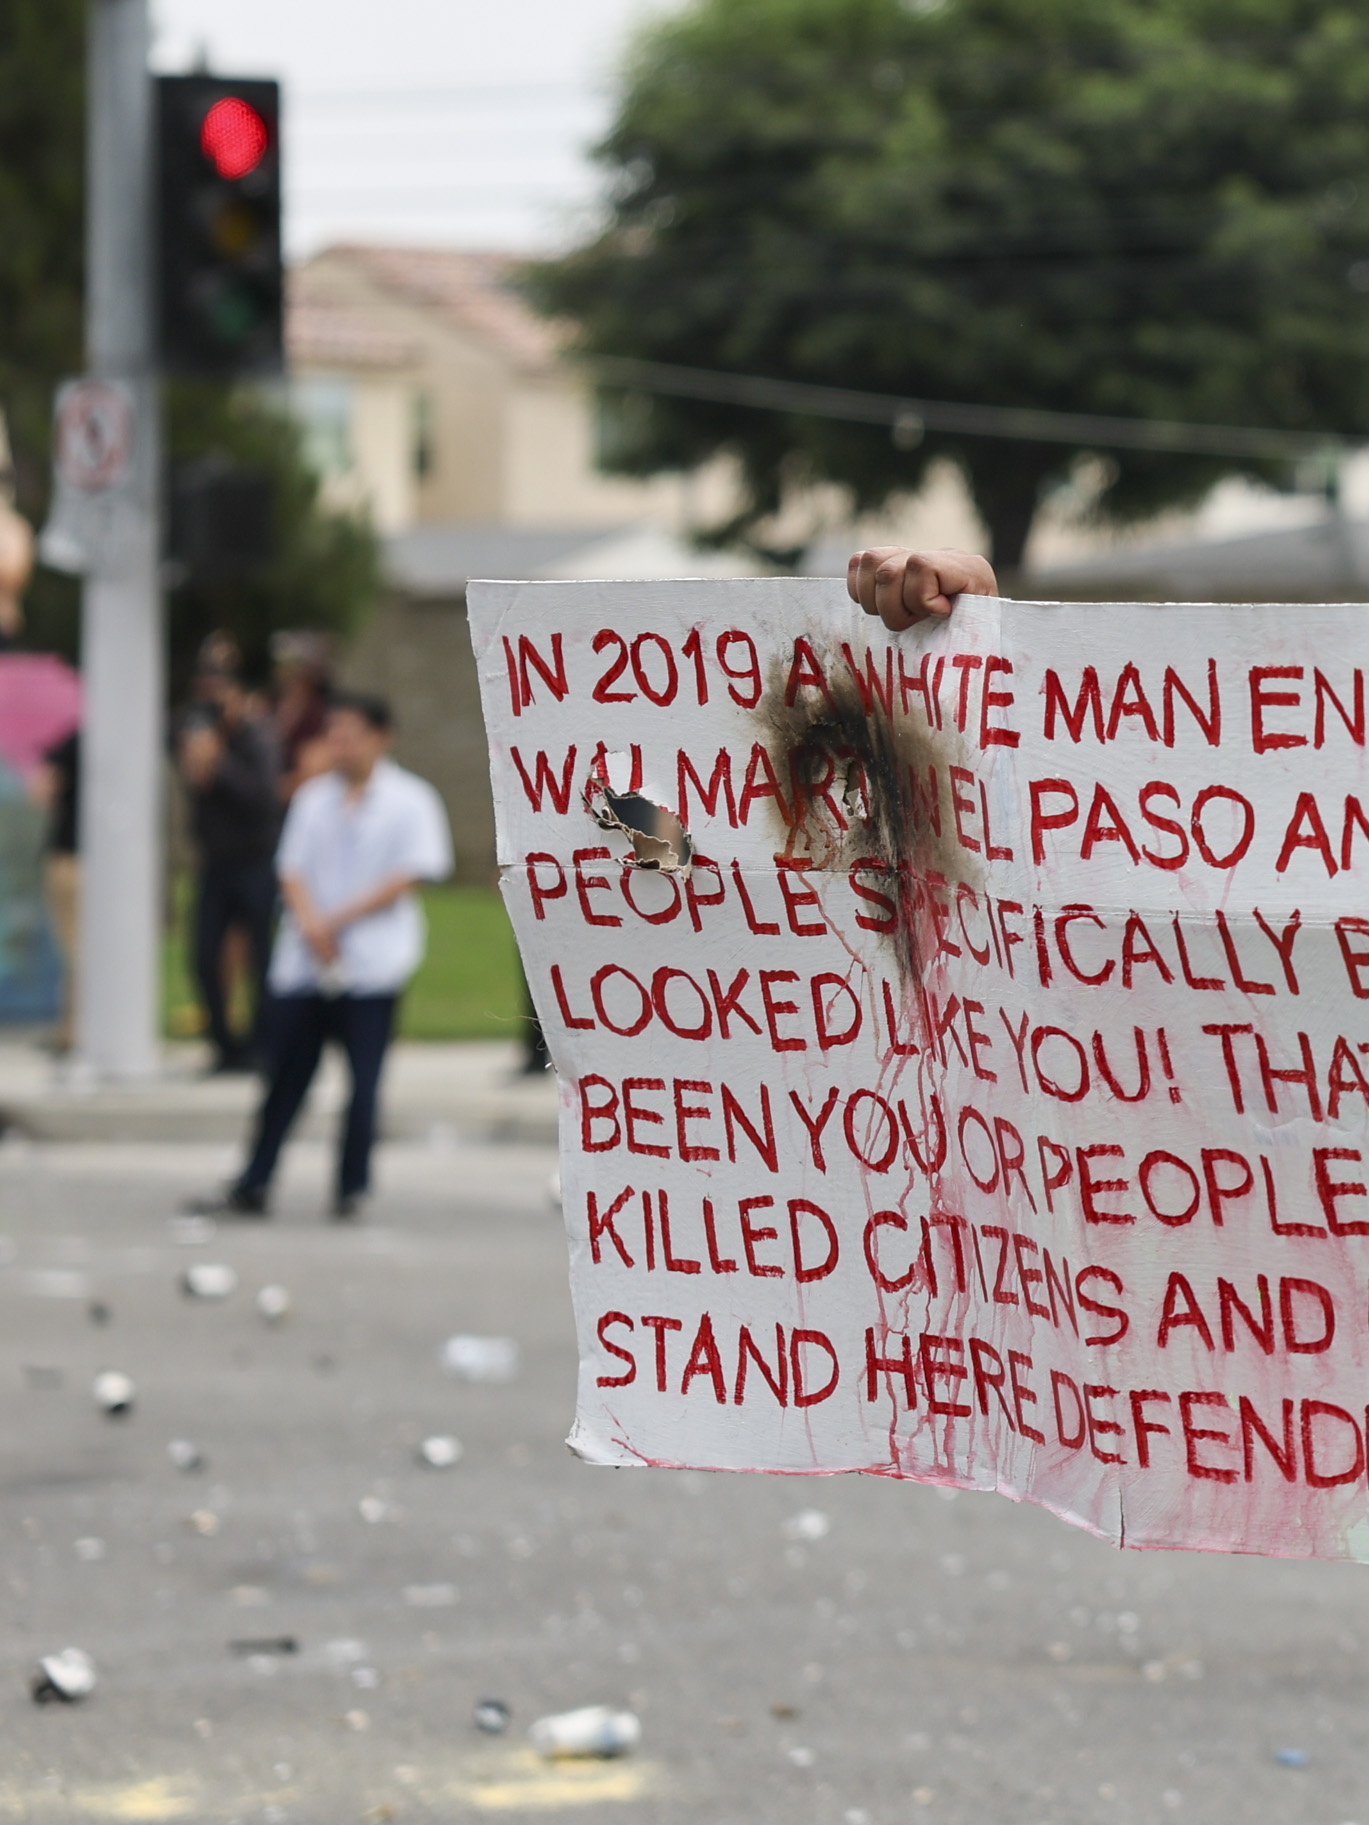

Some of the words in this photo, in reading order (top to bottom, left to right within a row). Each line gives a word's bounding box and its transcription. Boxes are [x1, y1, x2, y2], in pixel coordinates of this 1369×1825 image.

[502, 631, 569, 718] IN
[591, 626, 763, 710] 2019
[784, 636, 841, 722] A
[841, 642, 1021, 751] WHITE
[1041, 658, 1220, 748] MAN
[949, 764, 1015, 863] EL
[1028, 777, 1255, 871] PASO
[525, 851, 829, 938] PEOPLE
[550, 963, 863, 1053] LOOKED
[999, 1004, 1184, 1105] YOU!
[577, 1072, 781, 1174] BEEN
[788, 1084, 948, 1177] YOU
[956, 1103, 1038, 1215] OR
[586, 1184, 840, 1284] KILLED
[862, 1209, 1130, 1348] CITIZENS
[1156, 1271, 1336, 1356] AND
[596, 1309, 840, 1409] STAND
[864, 1325, 1045, 1446] HERE
